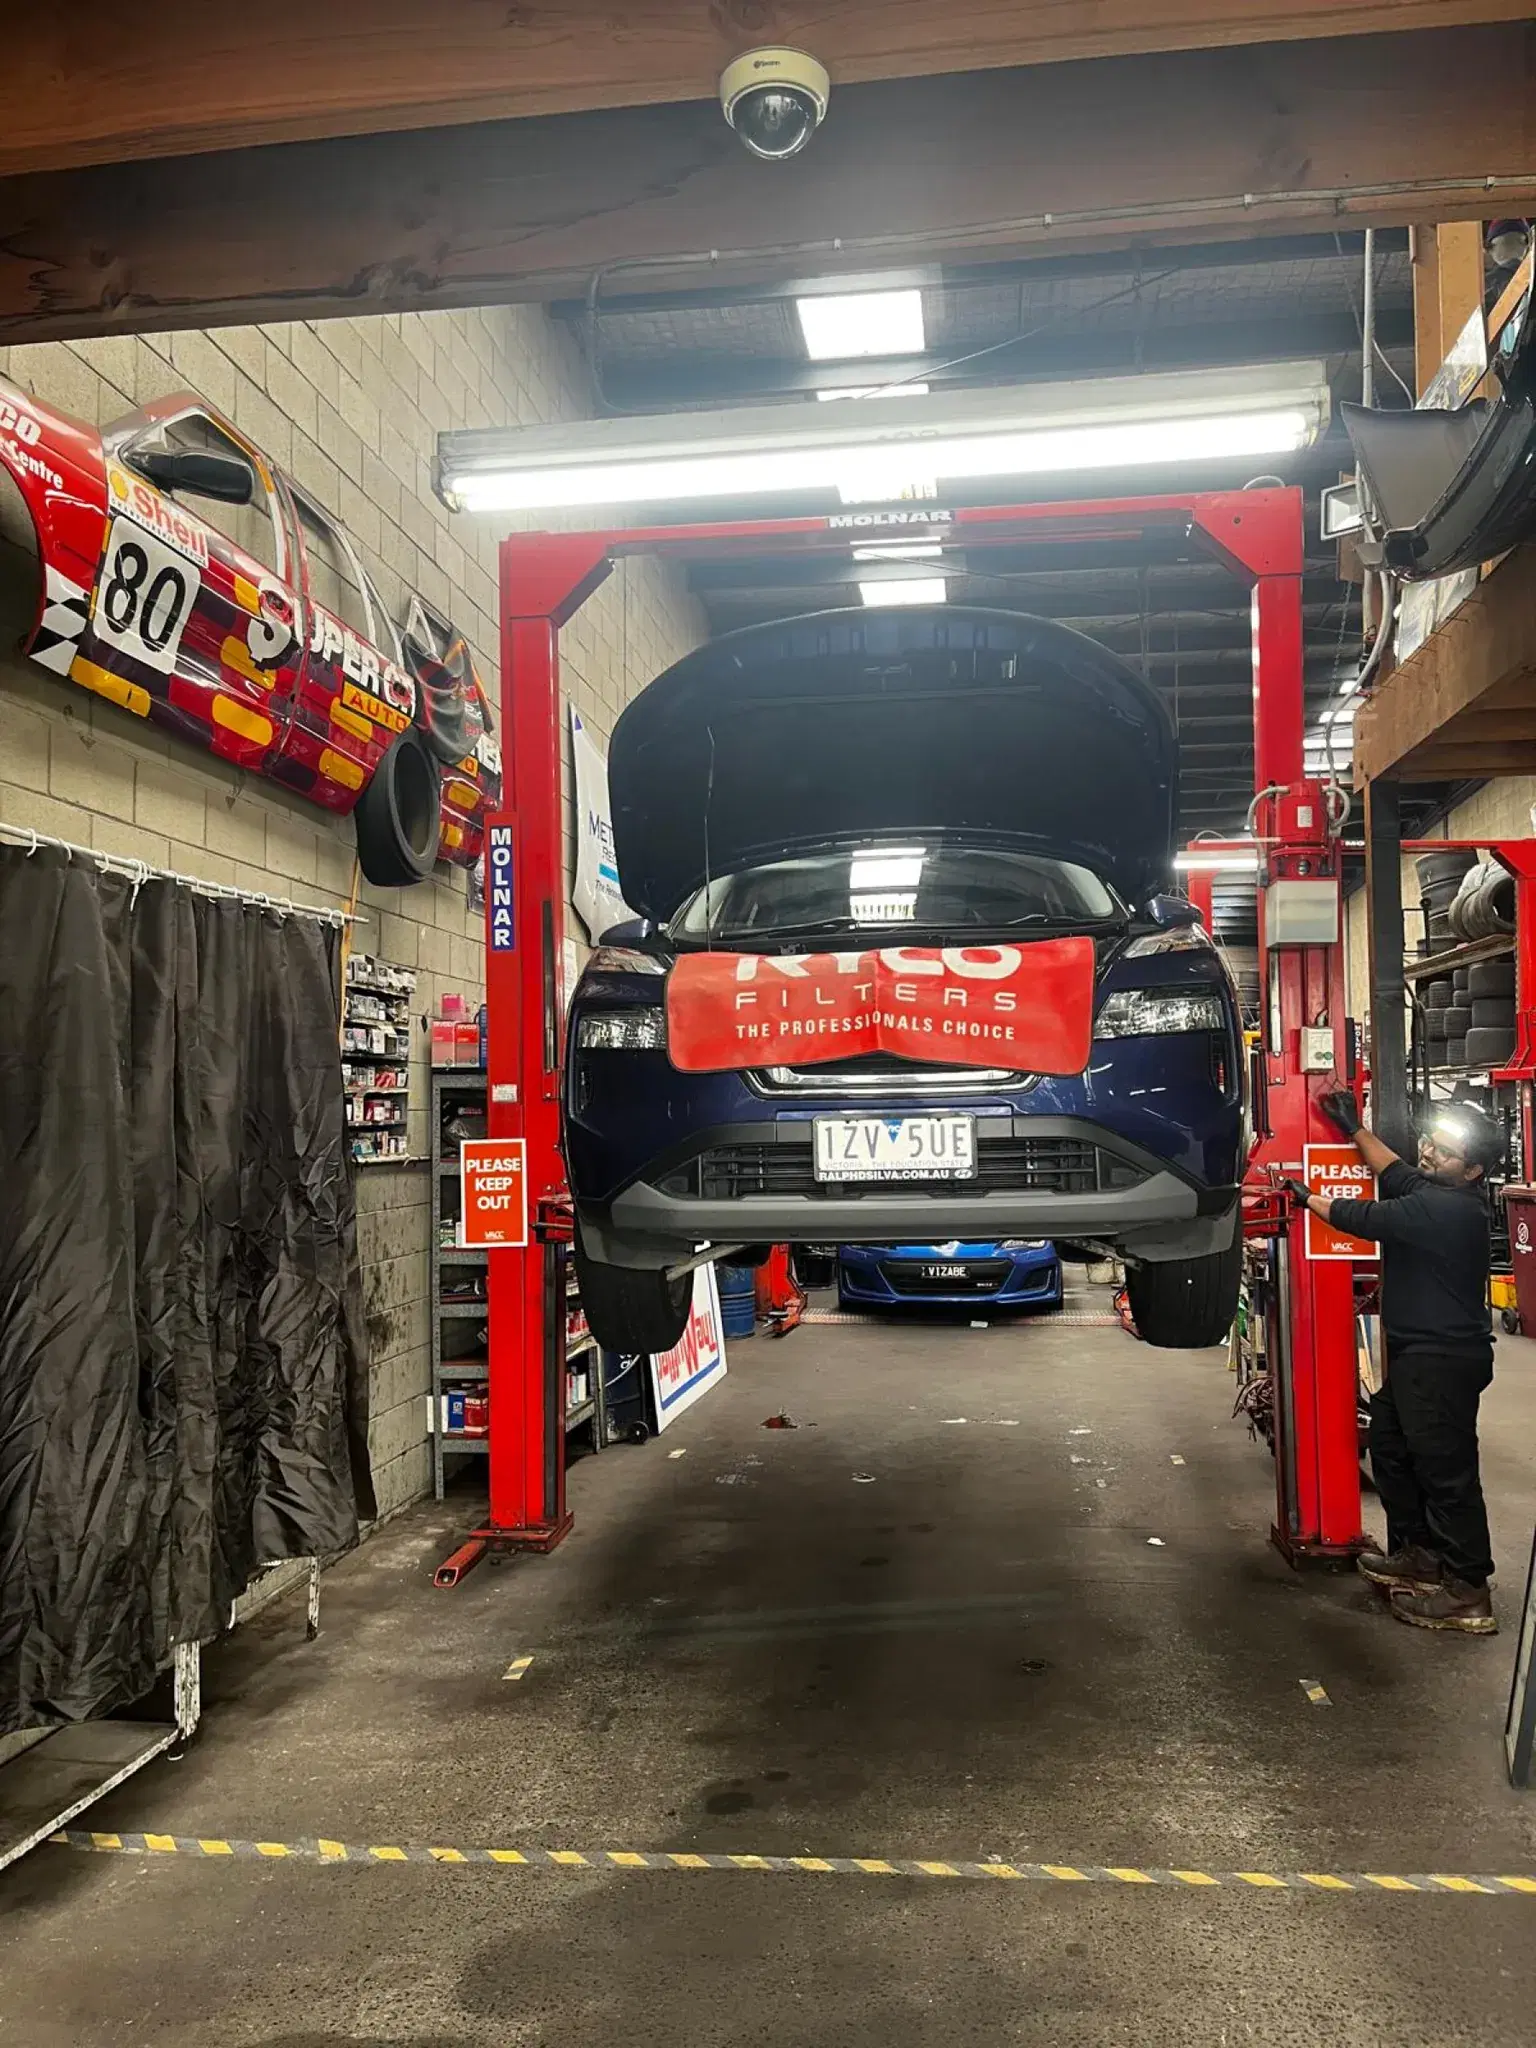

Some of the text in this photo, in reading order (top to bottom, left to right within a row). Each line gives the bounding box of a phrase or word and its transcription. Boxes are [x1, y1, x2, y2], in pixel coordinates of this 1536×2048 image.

[133, 484, 206, 559] Shell
[829, 511, 952, 528] MOLNAR
[104, 541, 187, 653] 80
[349, 690, 408, 732] AUTO
[490, 828, 512, 946] MOLNAR
[736, 983, 1017, 1010] FILTERS
[736, 1010, 1015, 1040] THE PROFESSIONALS CHOICE
[825, 1124, 968, 1159] 1ZV 5UE
[466, 1157, 521, 1173] PLEASE
[1310, 1164, 1373, 1180] PLEASE
[819, 1169, 950, 1181] RALPHDSILVA.COM.AU
[475, 1177, 513, 1191] KEEP
[1320, 1184, 1363, 1199] KEEP
[477, 1195, 511, 1210] OUT
[1331, 1242, 1354, 1251] VACC
